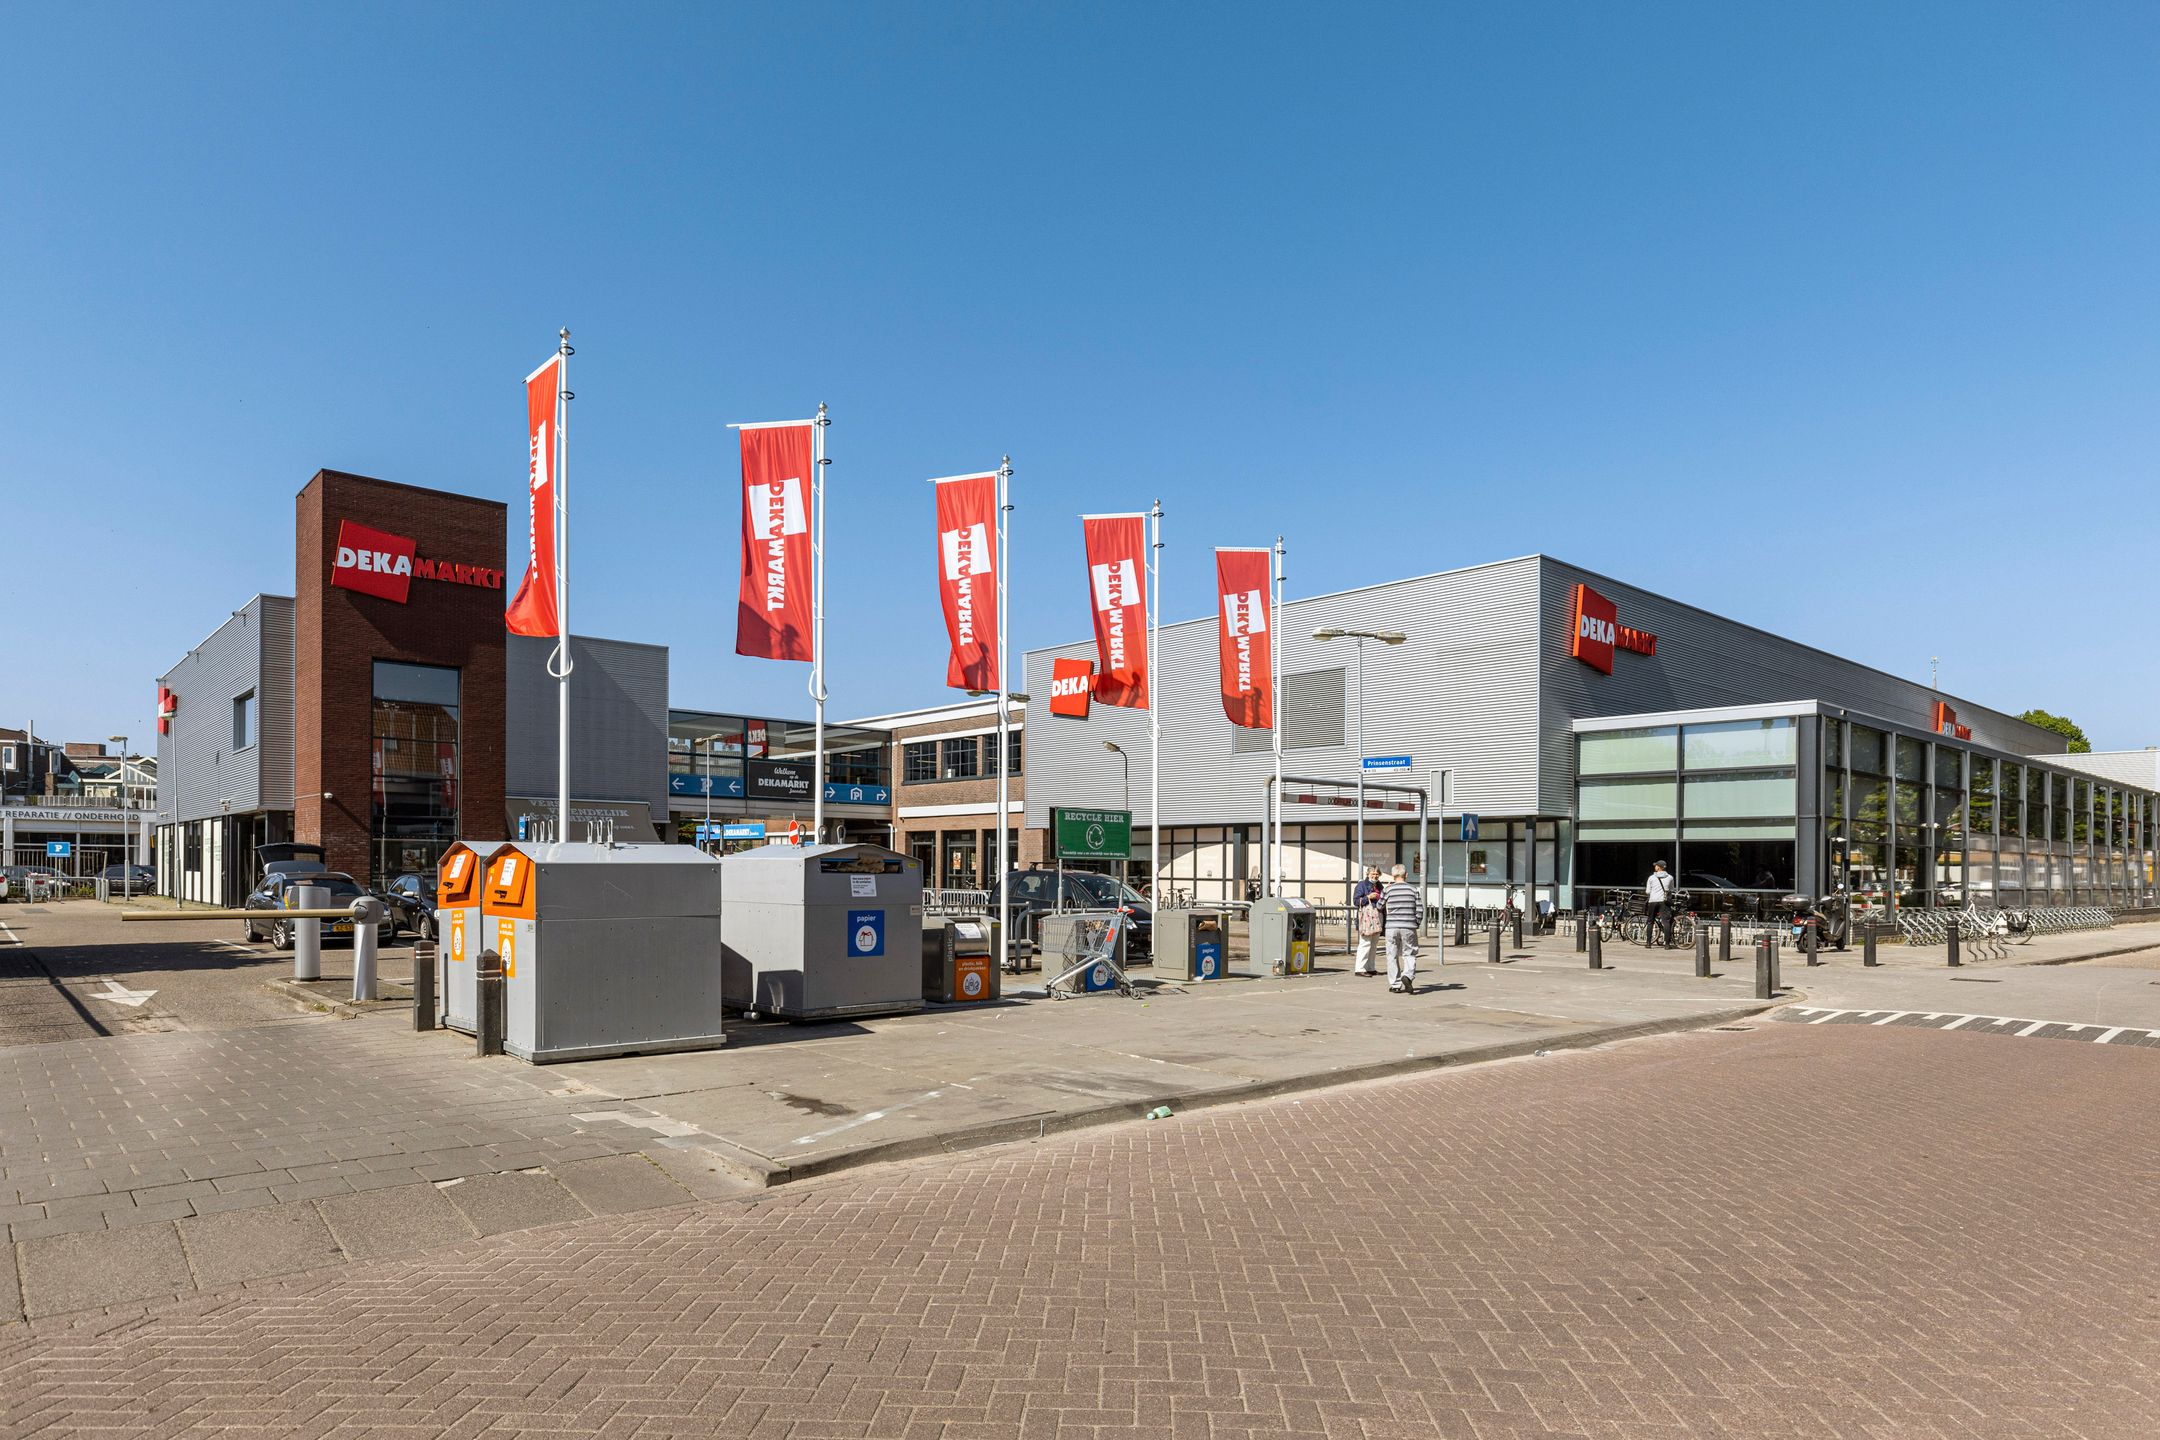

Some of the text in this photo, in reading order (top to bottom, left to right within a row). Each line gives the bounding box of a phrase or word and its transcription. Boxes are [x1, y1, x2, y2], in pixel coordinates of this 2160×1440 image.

[1367, 759, 1406, 767] Prinsenstraat
[758, 778, 810, 789] DEKAMARKT
[5, 810, 59, 819] REPARATIE
[1064, 812, 1124, 823] RECYCLE HIER
[856, 915, 877, 923] papier
